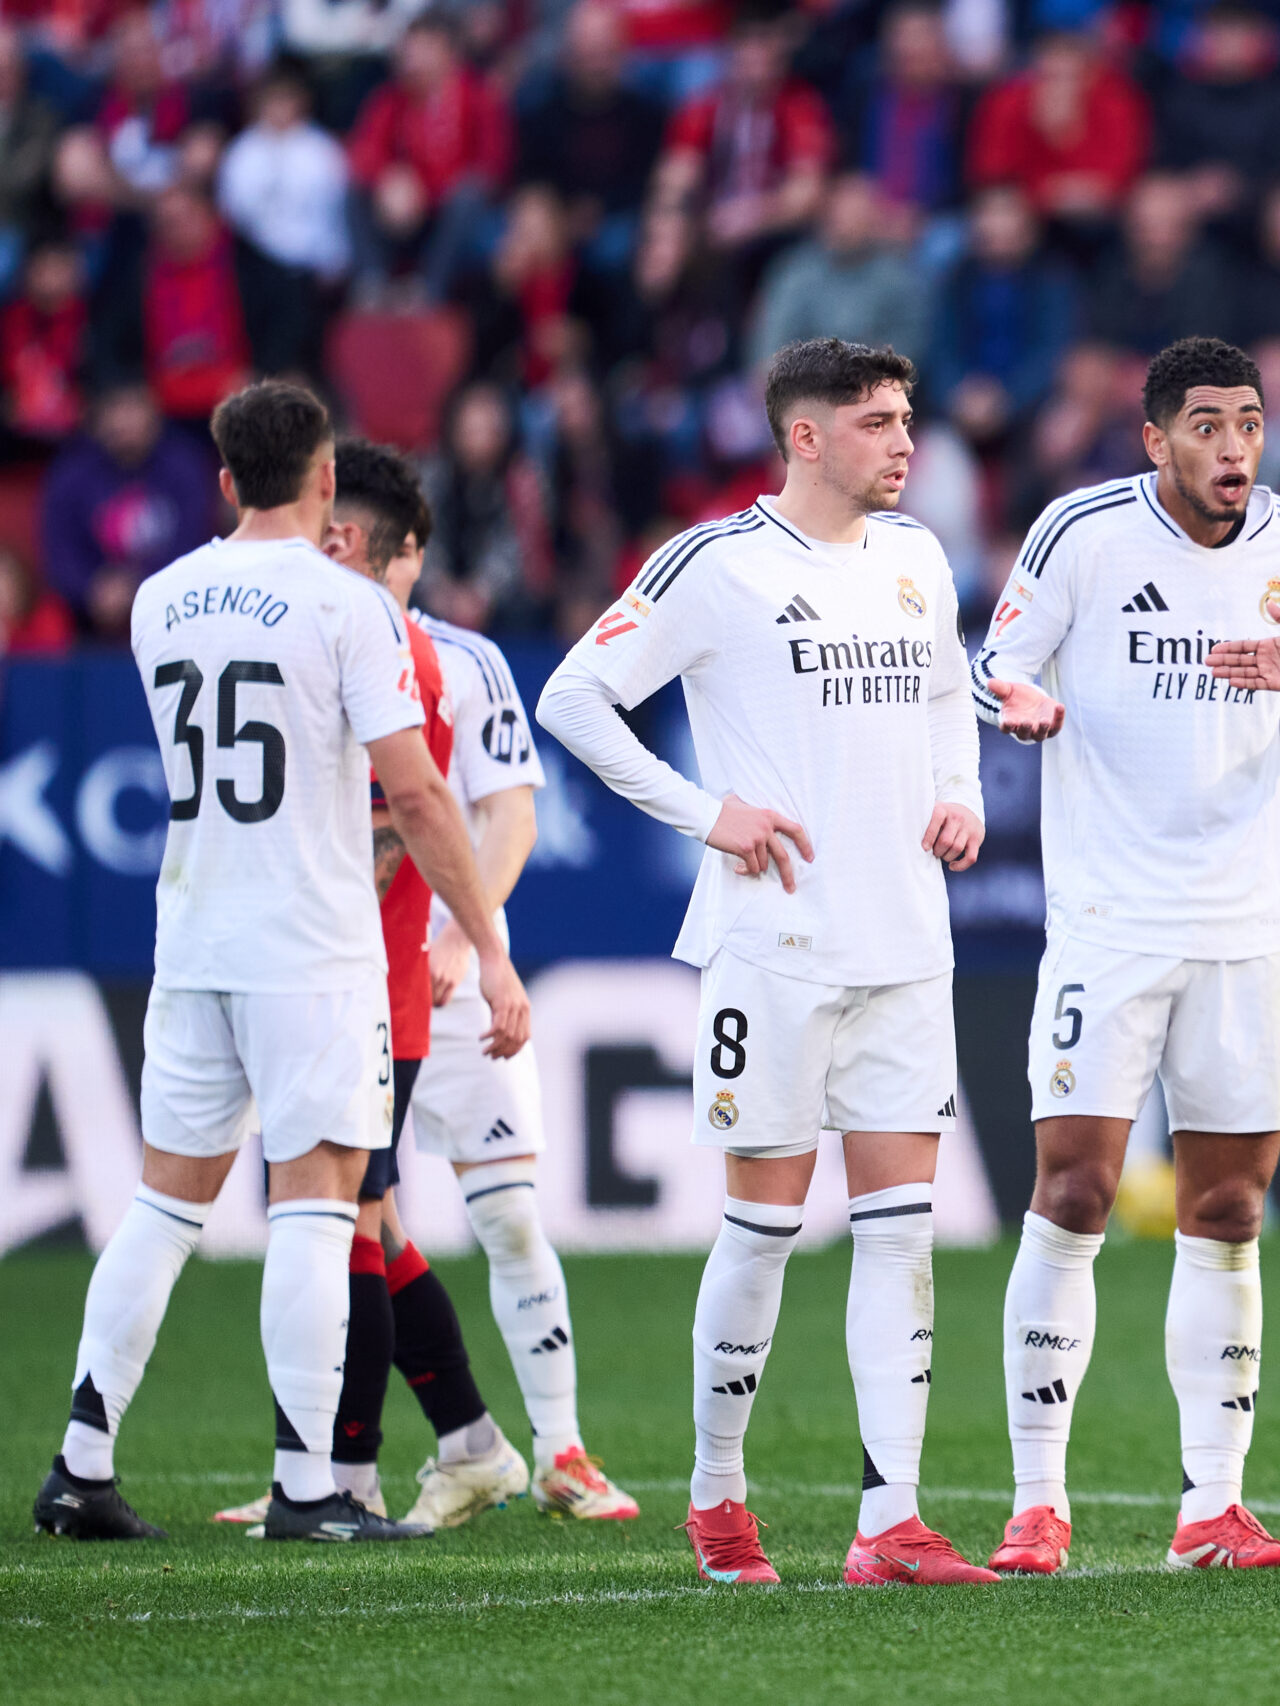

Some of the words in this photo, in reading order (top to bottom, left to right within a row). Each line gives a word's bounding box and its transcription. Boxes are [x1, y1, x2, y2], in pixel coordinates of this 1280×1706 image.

[165, 586, 289, 632] ASENCIO
[788, 634, 932, 674] Emirates
[822, 677, 853, 707] FLY
[862, 676, 921, 704] BETTER
[1152, 672, 1188, 700] FLY
[154, 659, 286, 824] 35
[482, 708, 530, 764] hp
[1052, 983, 1085, 1050] 5
[710, 1008, 748, 1079] 8
[1025, 1330, 1081, 1352] RMCF
